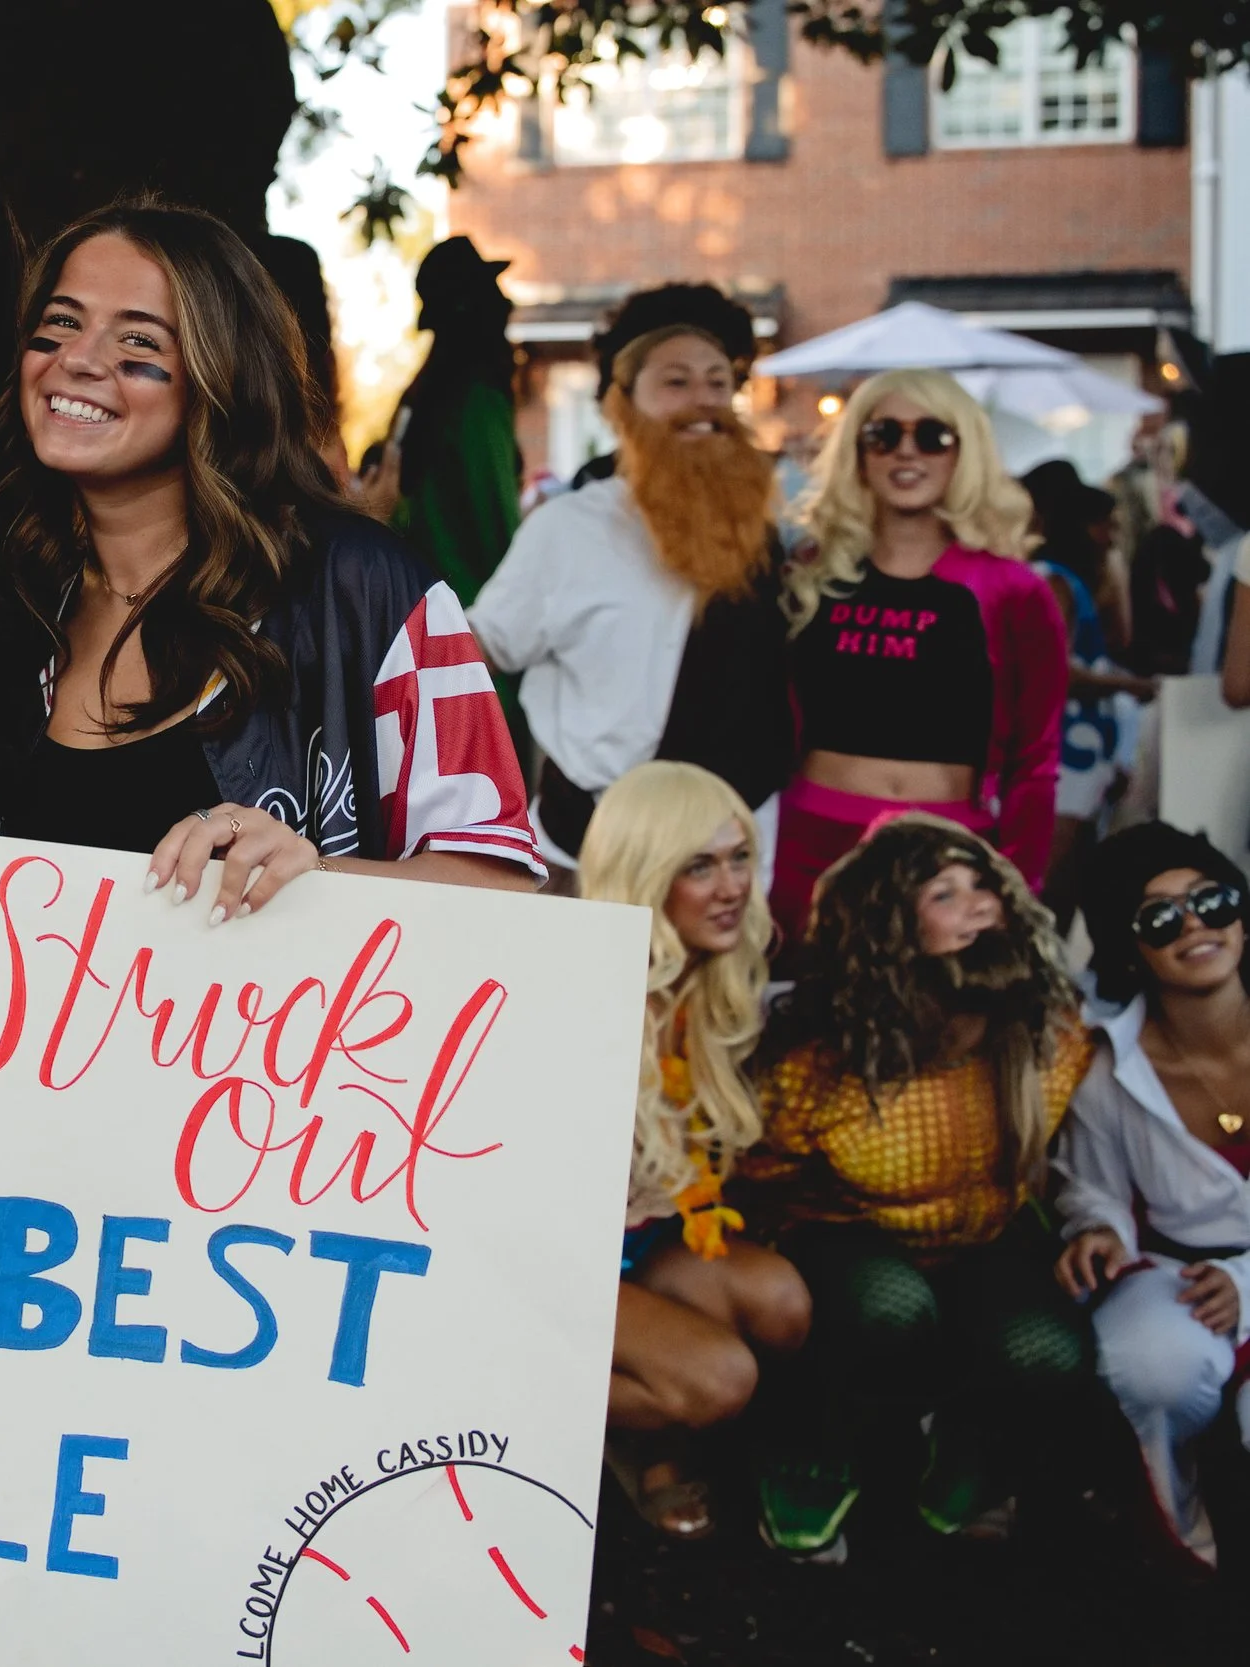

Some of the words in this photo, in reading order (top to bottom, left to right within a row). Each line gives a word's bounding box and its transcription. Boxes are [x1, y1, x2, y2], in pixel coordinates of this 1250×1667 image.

[830, 603, 937, 632] DUMP
[836, 630, 917, 660] HIM
[284, 1464, 364, 1539] HOME
[377, 1430, 509, 1474] CASSIDY
